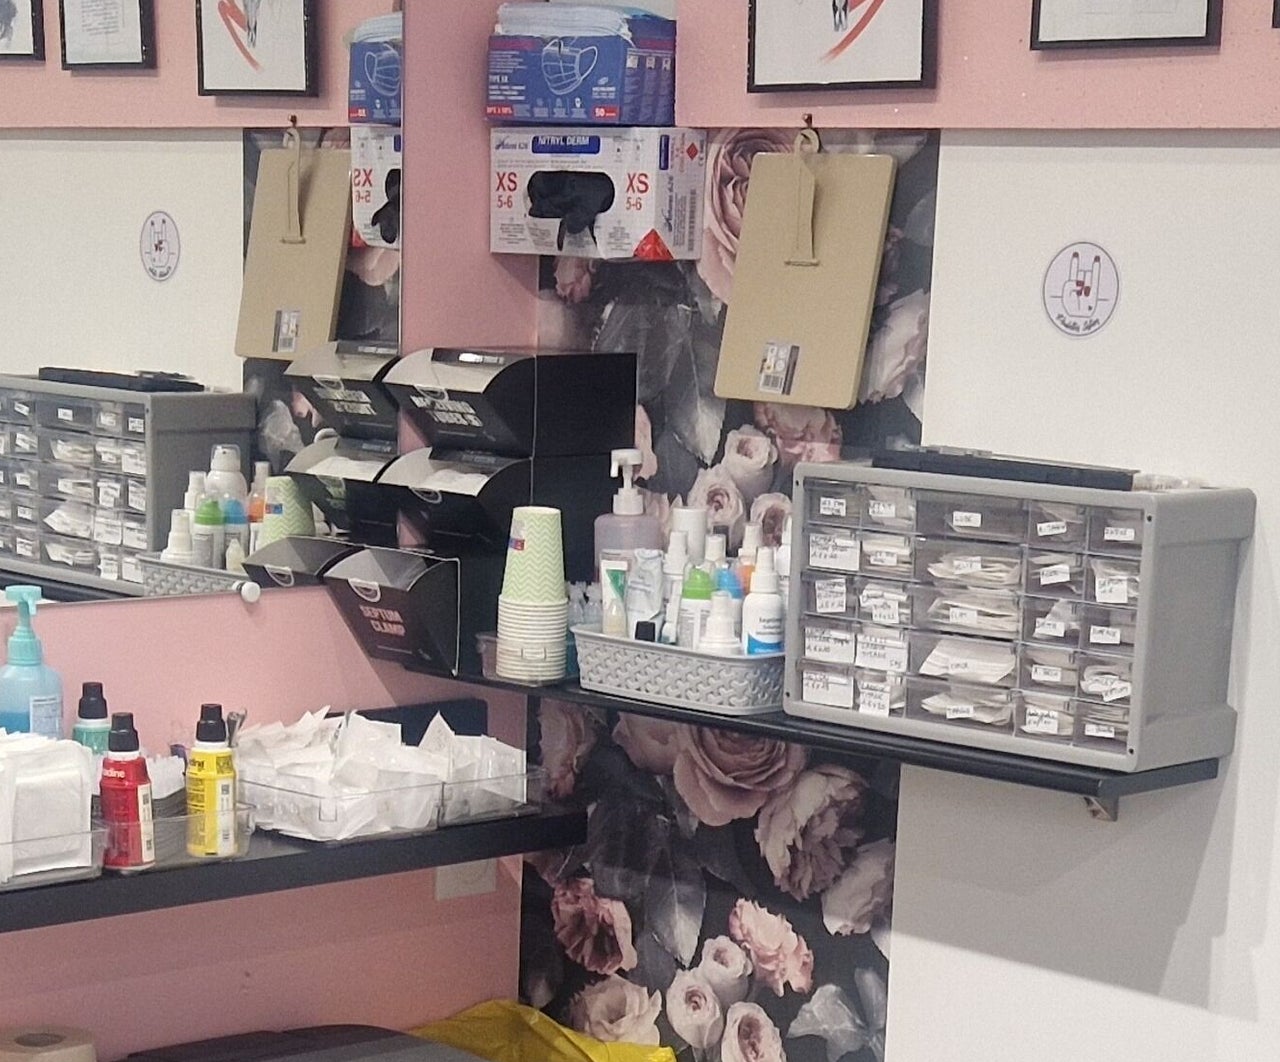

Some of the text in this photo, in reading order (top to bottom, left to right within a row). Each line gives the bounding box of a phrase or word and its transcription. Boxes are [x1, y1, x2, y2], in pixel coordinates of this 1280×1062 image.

[495, 171, 518, 192] XS
[625, 172, 650, 194] XS
[496, 194, 514, 209] 5-6
[625, 196, 643, 211] 5-6
[358, 604, 404, 623] SEPTUM
[370, 620, 406, 637] CLAMP
